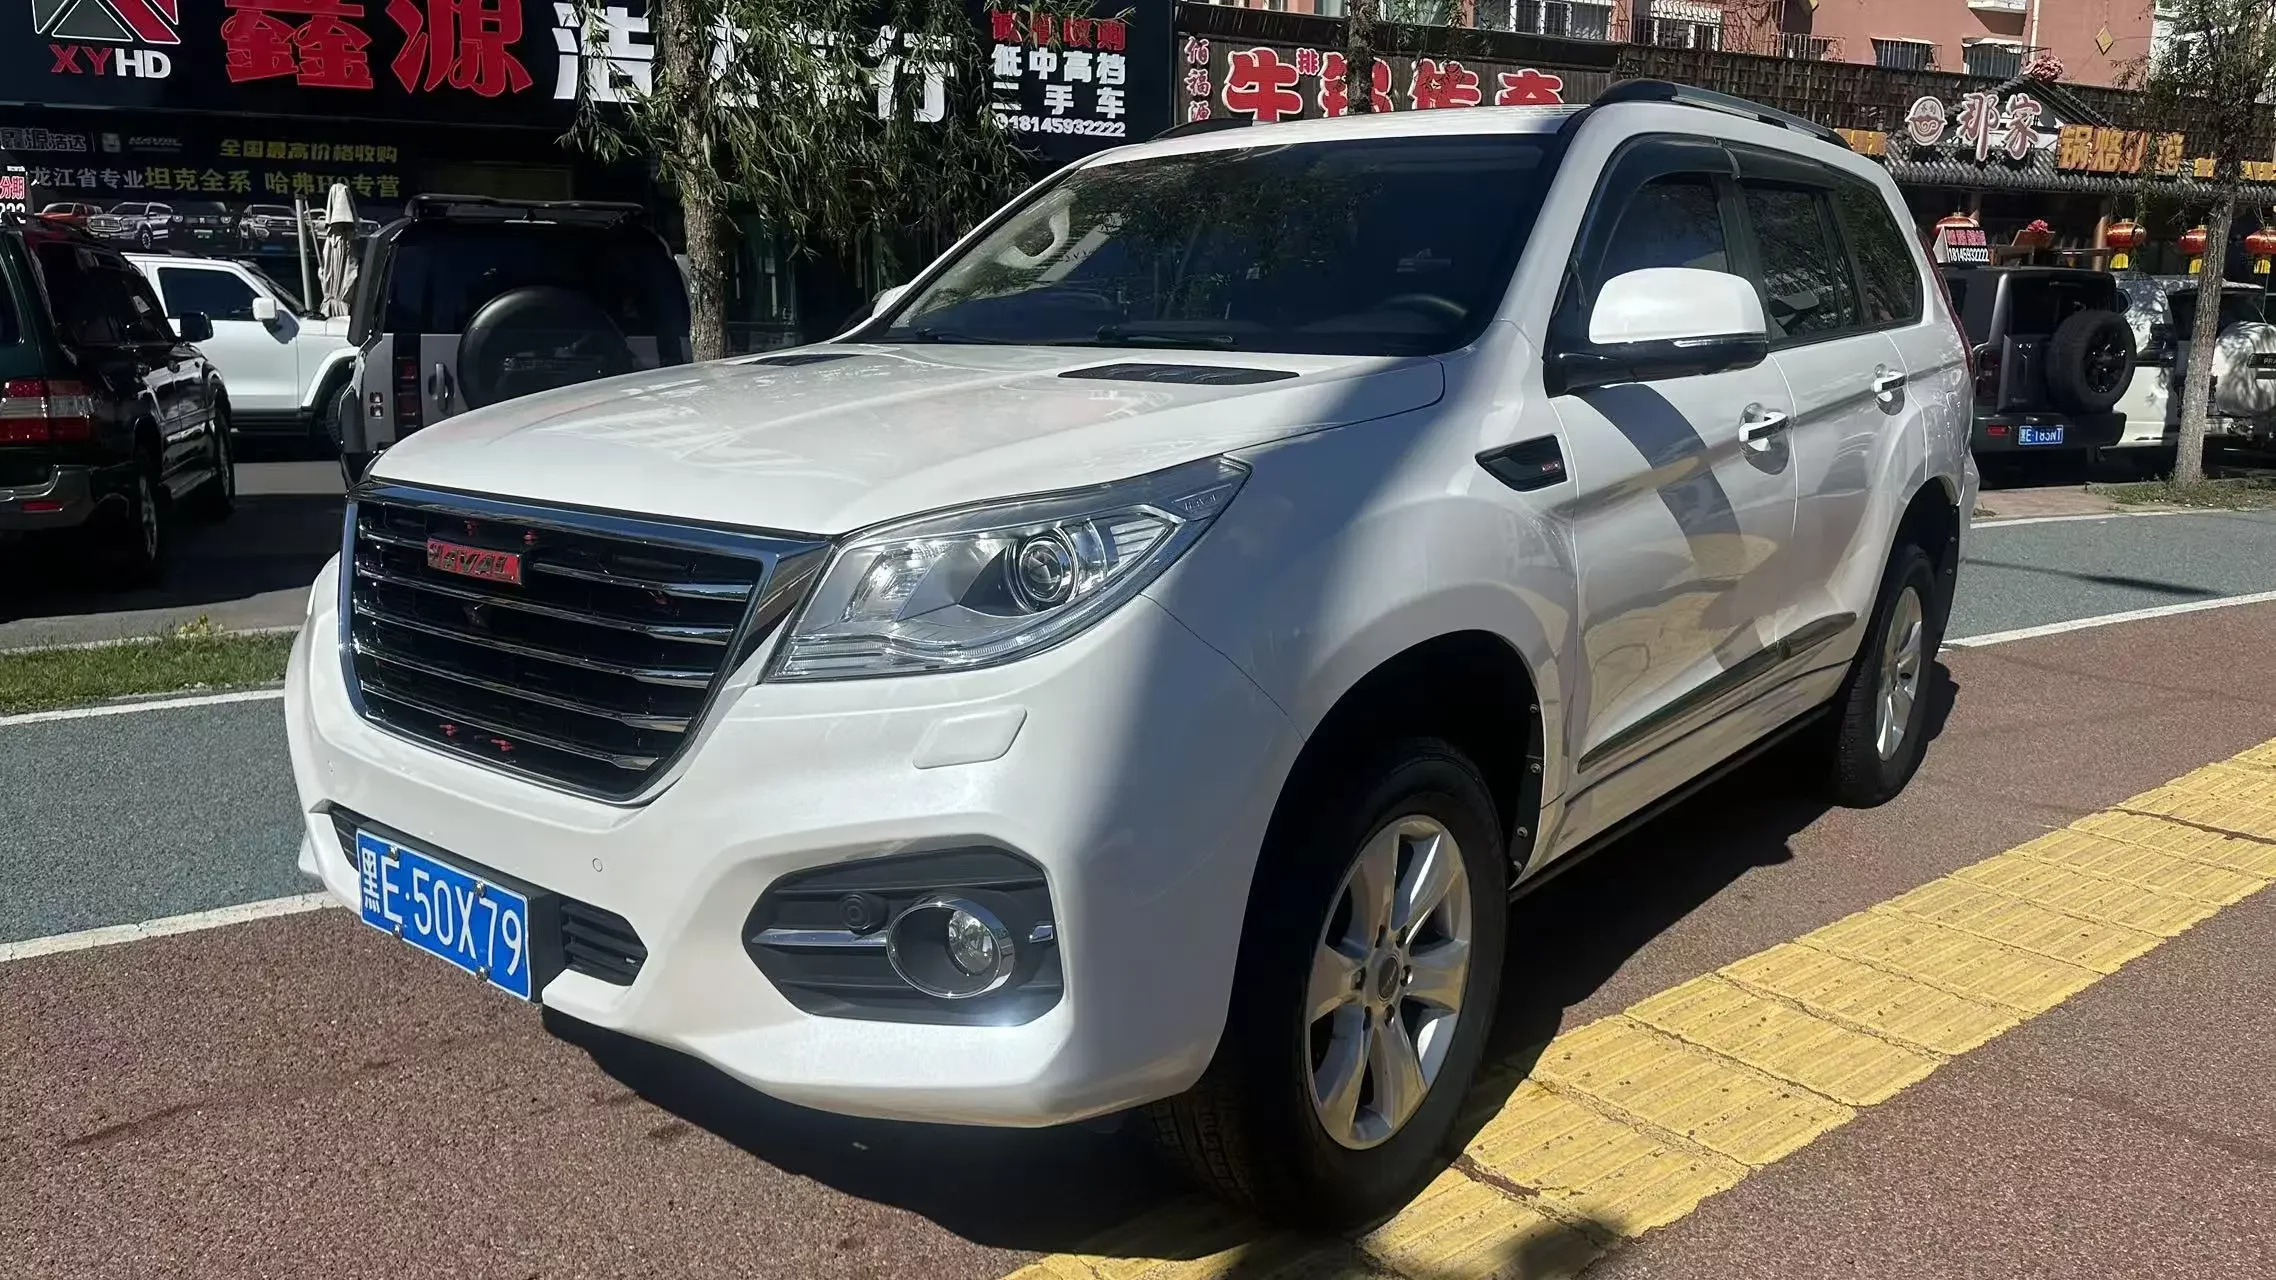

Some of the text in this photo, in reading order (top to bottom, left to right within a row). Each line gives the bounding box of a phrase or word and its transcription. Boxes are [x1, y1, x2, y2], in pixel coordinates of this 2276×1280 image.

[49, 44, 172, 79] XYHD
[991, 43, 1126, 85] 低中高档
[991, 82, 1126, 119] 二手车
[1956, 93, 2042, 161] 那家
[220, 138, 398, 164] 全国最高价格收购
[361, 847, 522, 976] 黑E·50X79
